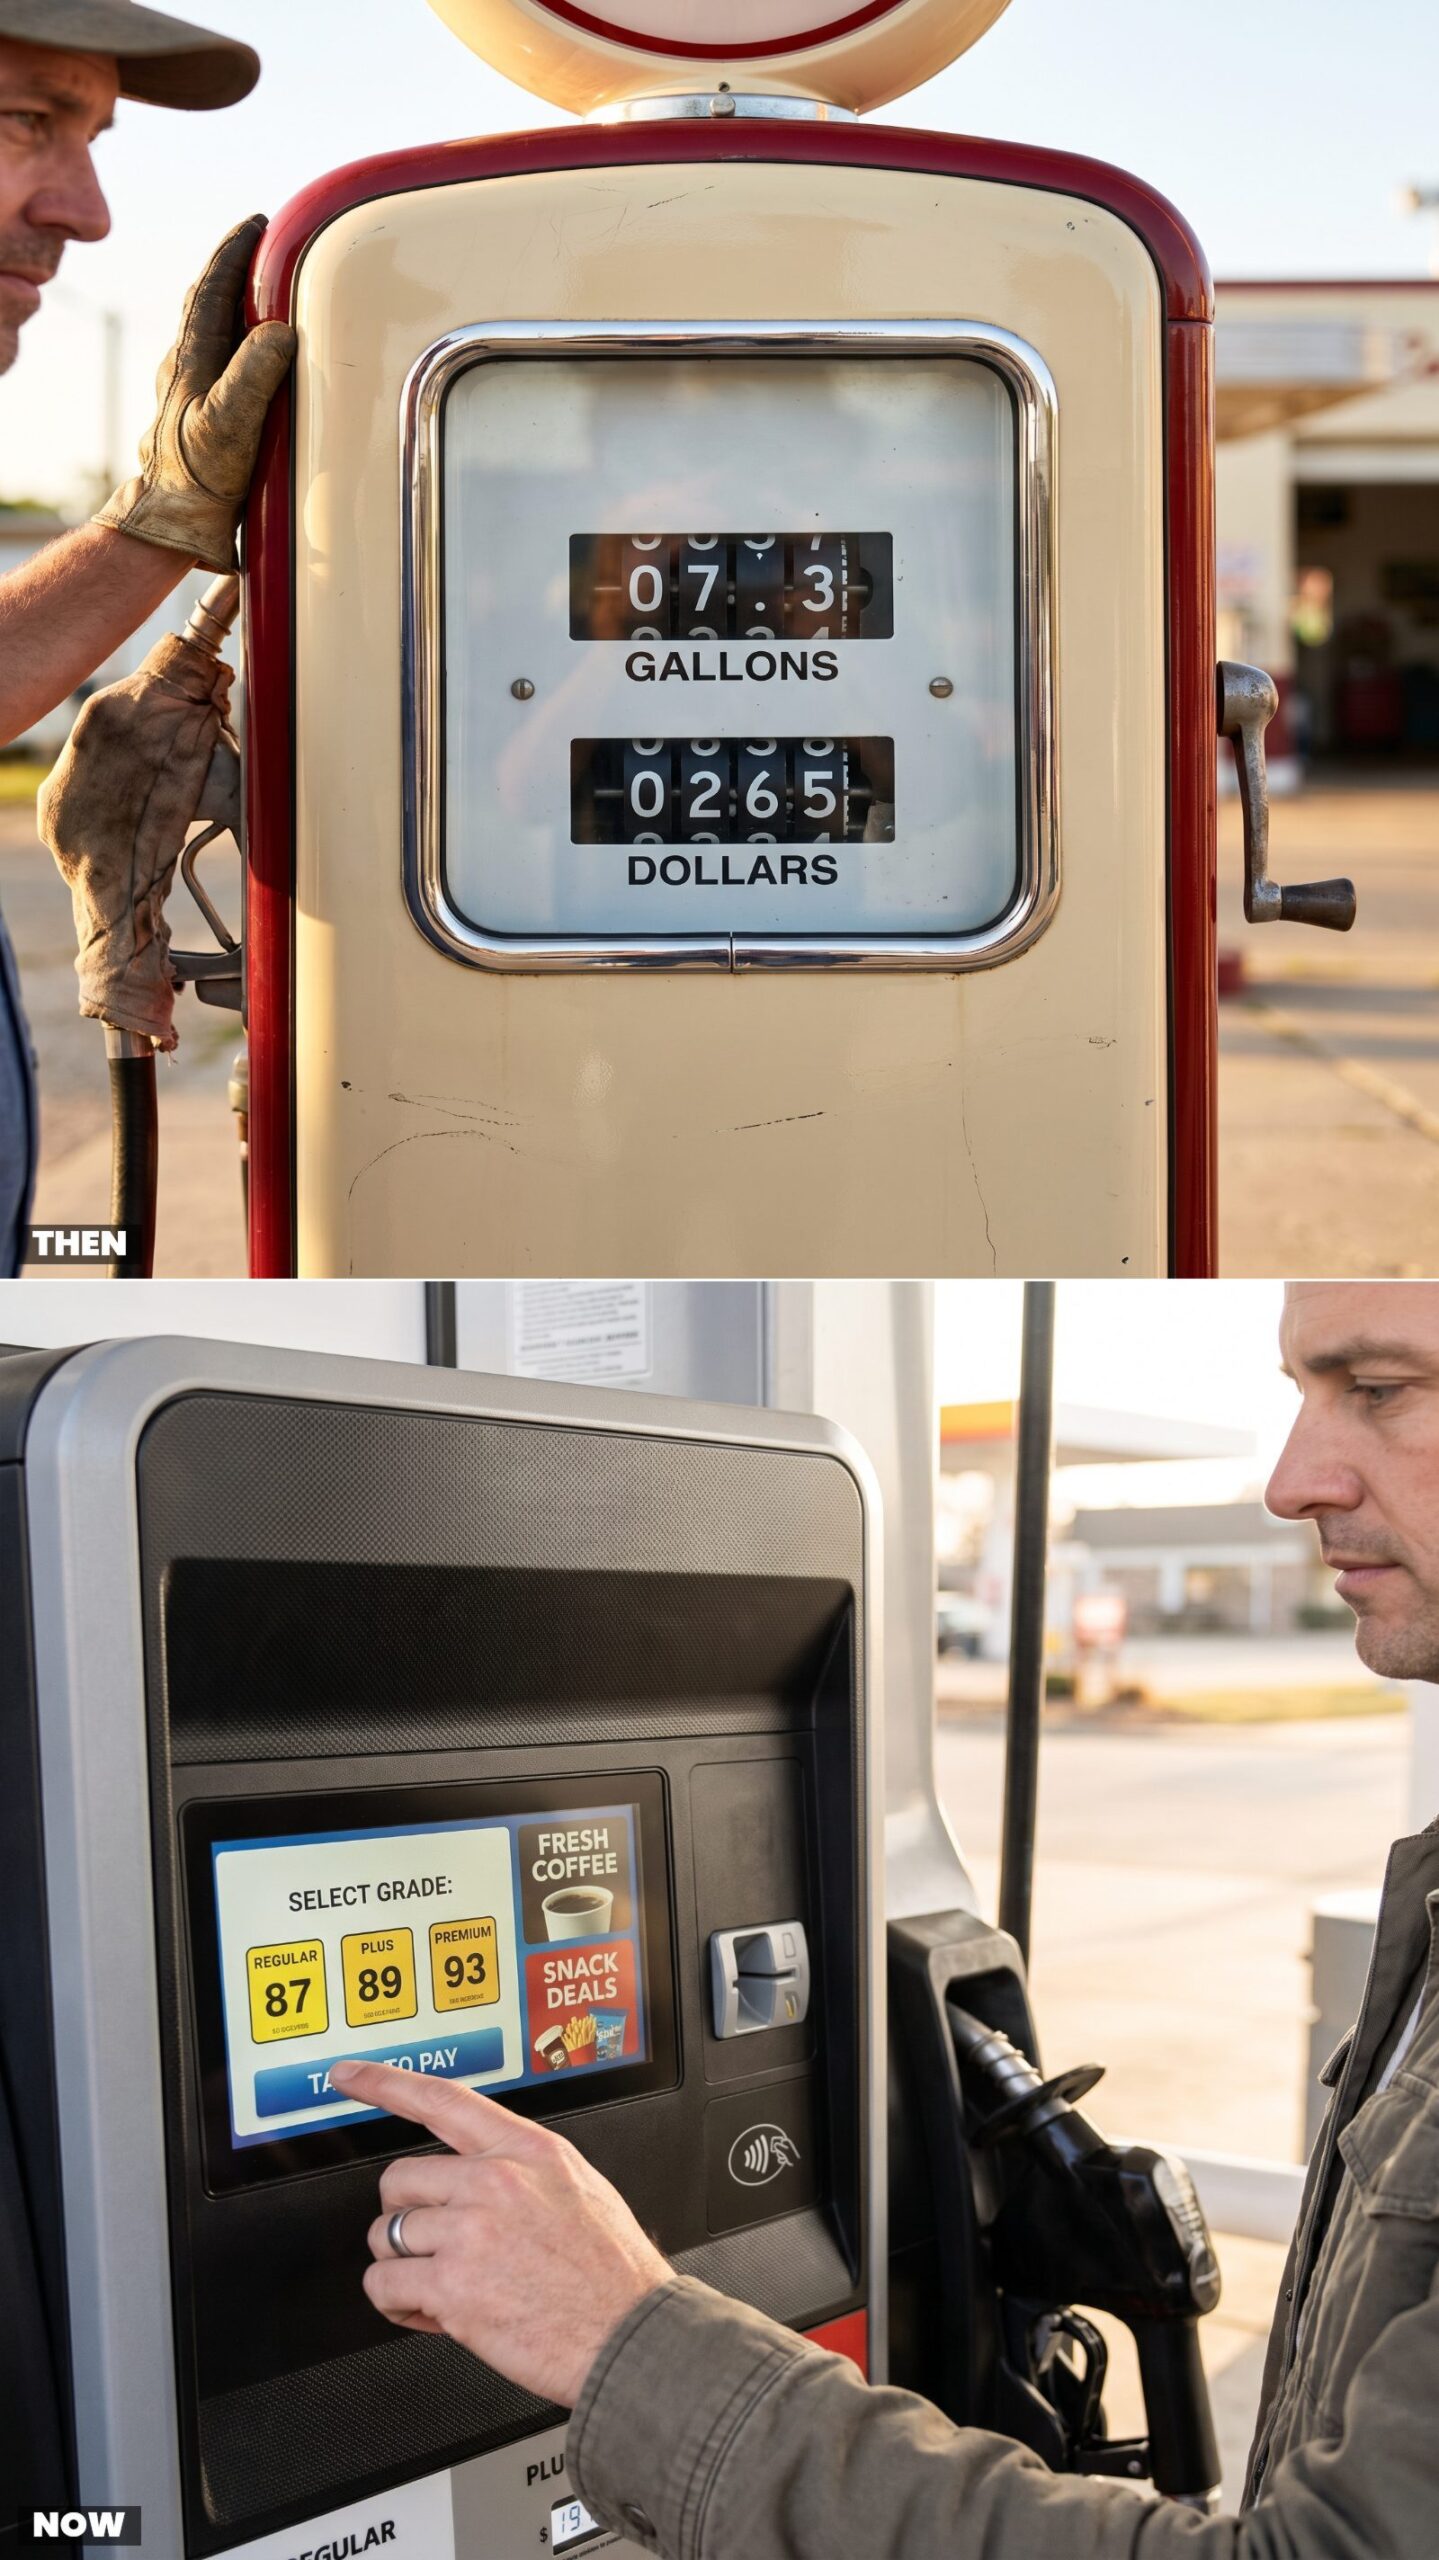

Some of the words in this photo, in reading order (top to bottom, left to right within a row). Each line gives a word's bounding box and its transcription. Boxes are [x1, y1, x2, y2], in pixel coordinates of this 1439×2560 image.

[625, 651, 838, 681] GALLONS
[630, 770, 836, 818] 0265
[628, 855, 838, 885] DOLLARS
[538, 1828, 608, 1855] FRESH
[532, 1852, 618, 1882] COFFEE
[289, 1884, 370, 1912] SELECT
[377, 1876, 452, 1902] GRADE:
[361, 1939, 394, 1955] PLUS
[435, 1926, 491, 1944] PREMIUM
[254, 1950, 318, 1970] REGULAR
[444, 1952, 486, 1988] 93
[543, 1952, 619, 1983] SNACK
[265, 1978, 311, 2017] 87
[358, 1966, 402, 2002] 89
[547, 1977, 617, 2009] DEALS
[307, 2071, 337, 2094] TA
[419, 2047, 458, 2073] PAY
[527, 2453, 564, 2486] PLU
[287, 2520, 396, 2560] GULAR
[540, 2526, 548, 2543] $
